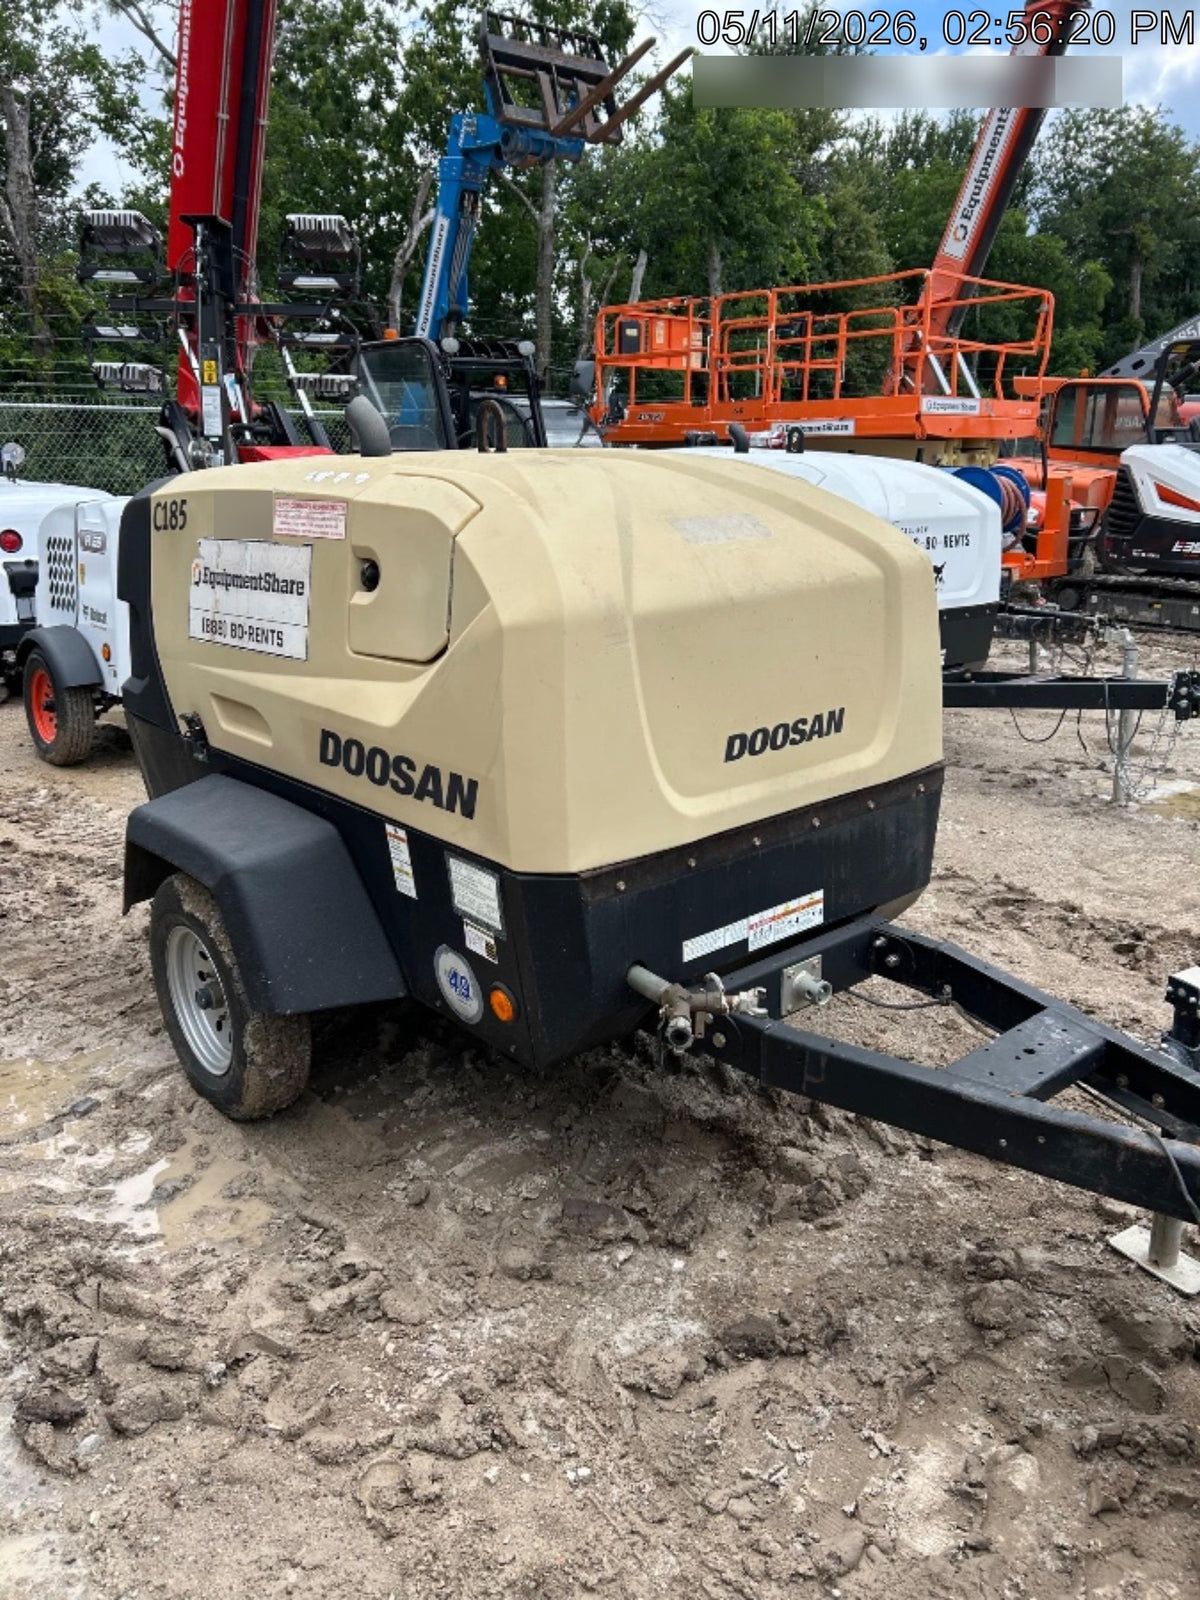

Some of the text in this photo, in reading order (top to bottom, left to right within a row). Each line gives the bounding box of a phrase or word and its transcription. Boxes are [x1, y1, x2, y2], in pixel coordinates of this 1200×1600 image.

[153, 499, 188, 532] C185
[202, 566, 305, 597] EquipmentShare
[724, 707, 846, 763] DOOSAN
[319, 728, 479, 820] DOOSAN
